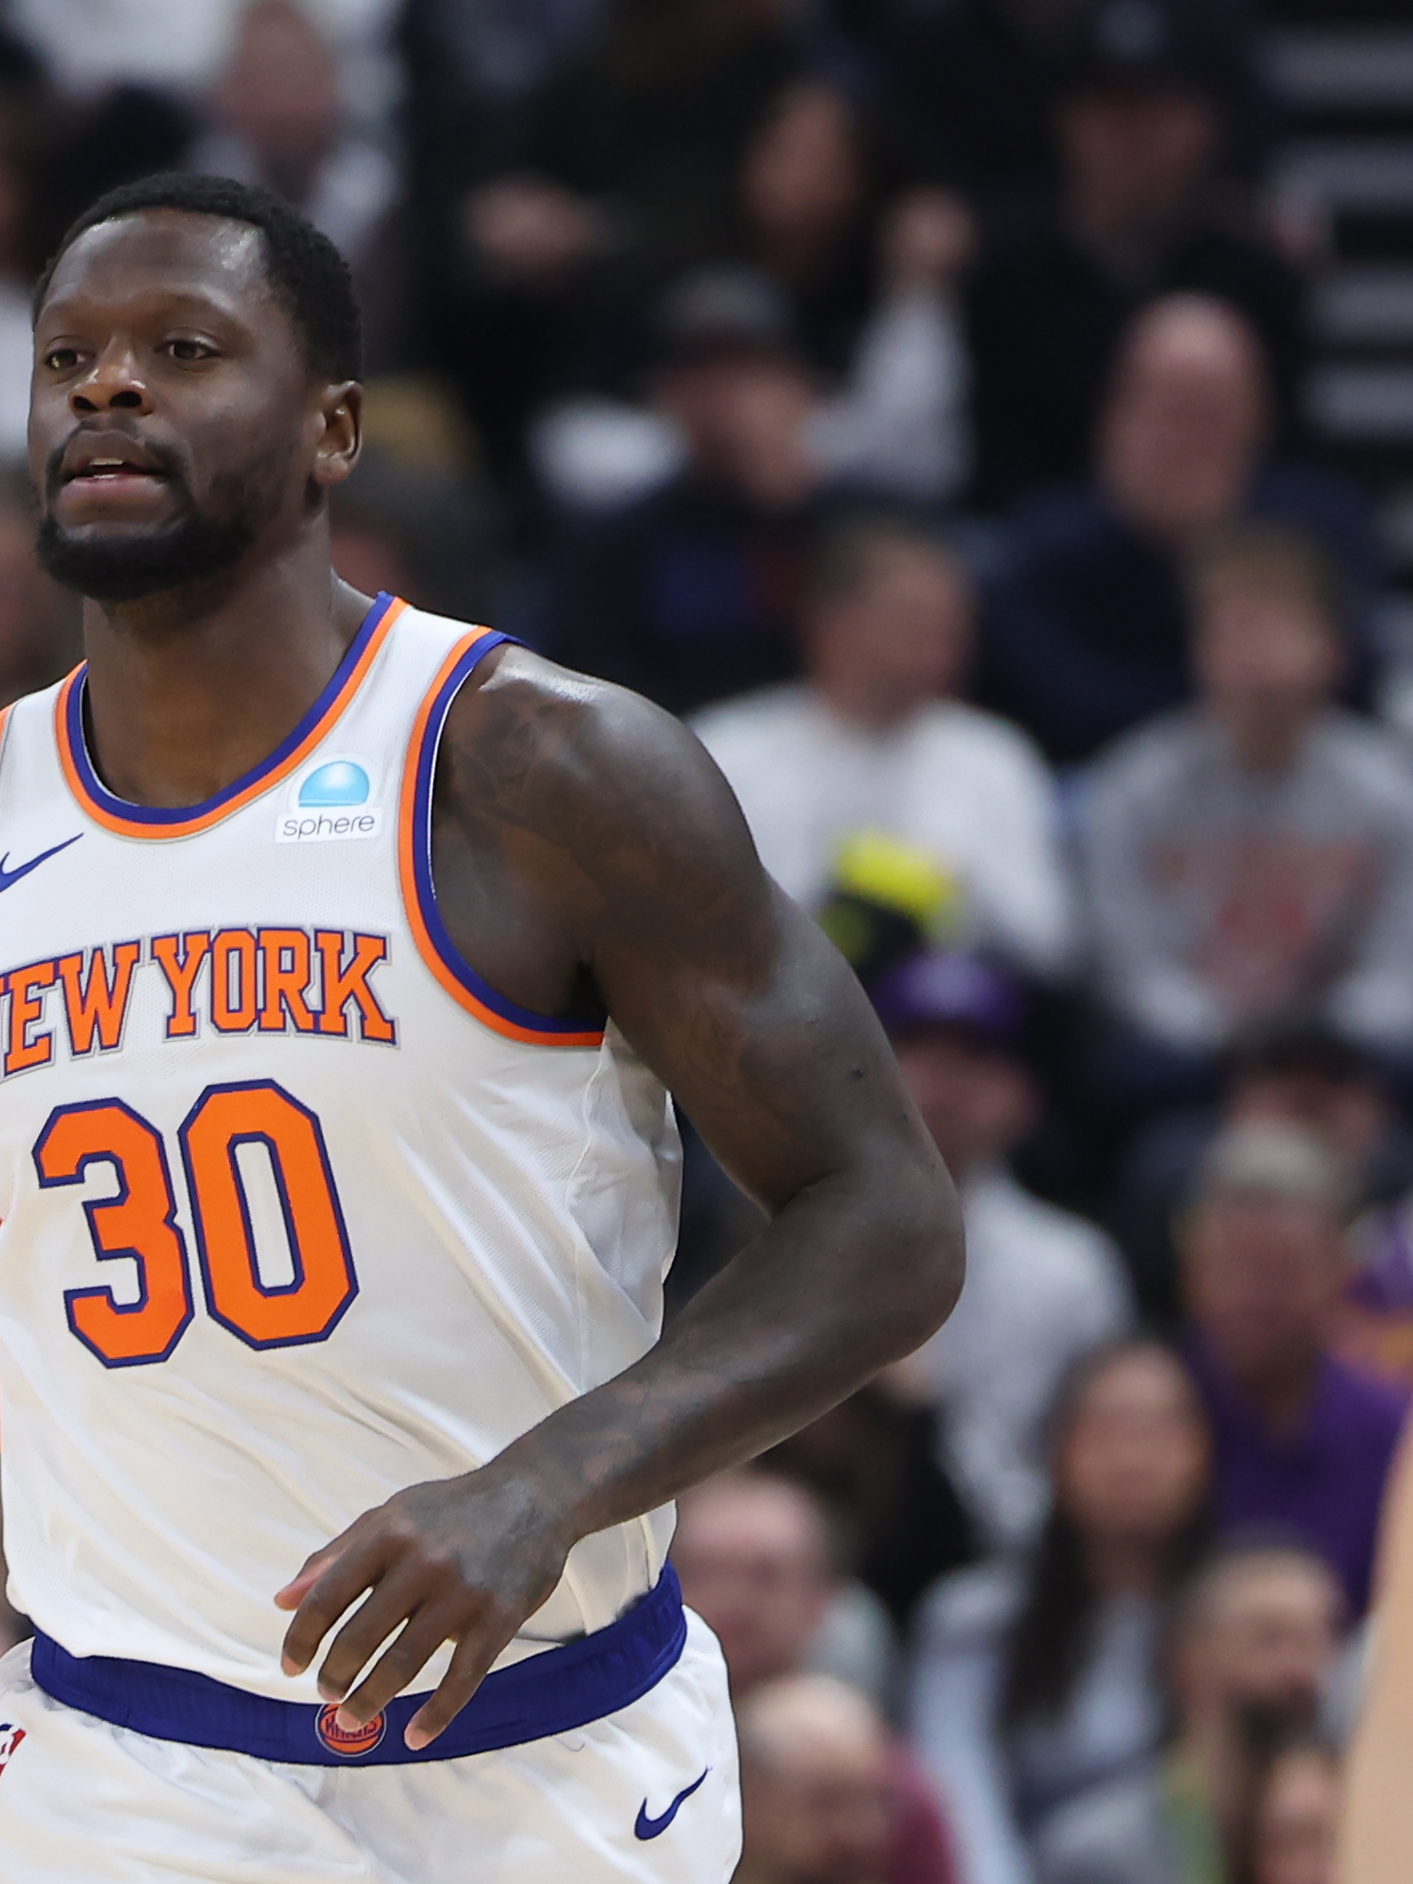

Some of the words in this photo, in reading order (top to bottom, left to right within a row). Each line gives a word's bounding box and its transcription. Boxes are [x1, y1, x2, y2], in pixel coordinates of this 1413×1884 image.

[283, 814, 375, 840] sphere
[151, 925, 398, 1046] YORK
[32, 1078, 359, 1369] 30
